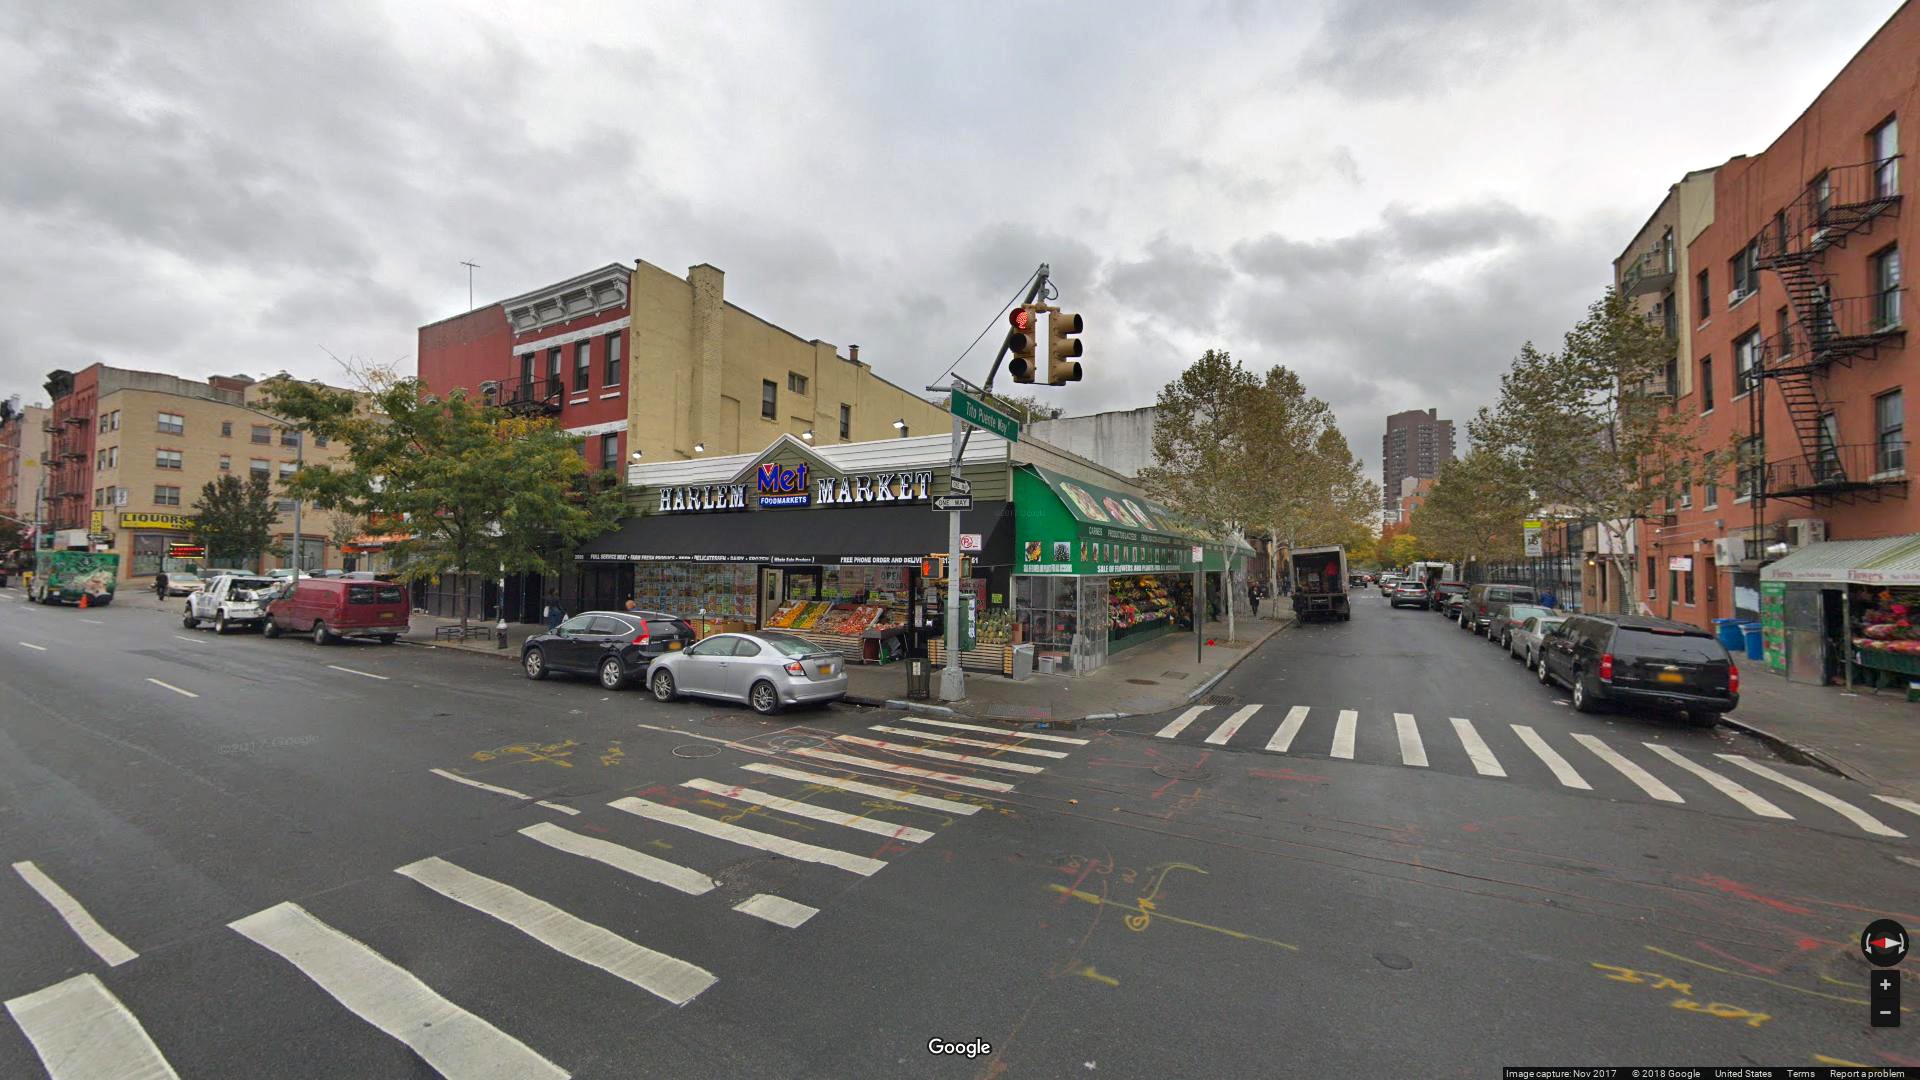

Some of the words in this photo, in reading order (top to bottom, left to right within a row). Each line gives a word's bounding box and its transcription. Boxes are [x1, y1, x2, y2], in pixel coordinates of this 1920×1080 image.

[966, 401, 977, 419] Tito
[979, 408, 996, 429] Puente
[998, 417, 1008, 436] Way
[757, 462, 807, 492] Met
[816, 471, 932, 504] MARKET
[659, 484, 749, 512] HARLEM
[760, 496, 807, 505] FOODMARKETS
[954, 499, 967, 507] WAY
[123, 514, 187, 525] LIQUORS
[1097, 564, 1108, 573] SALE
